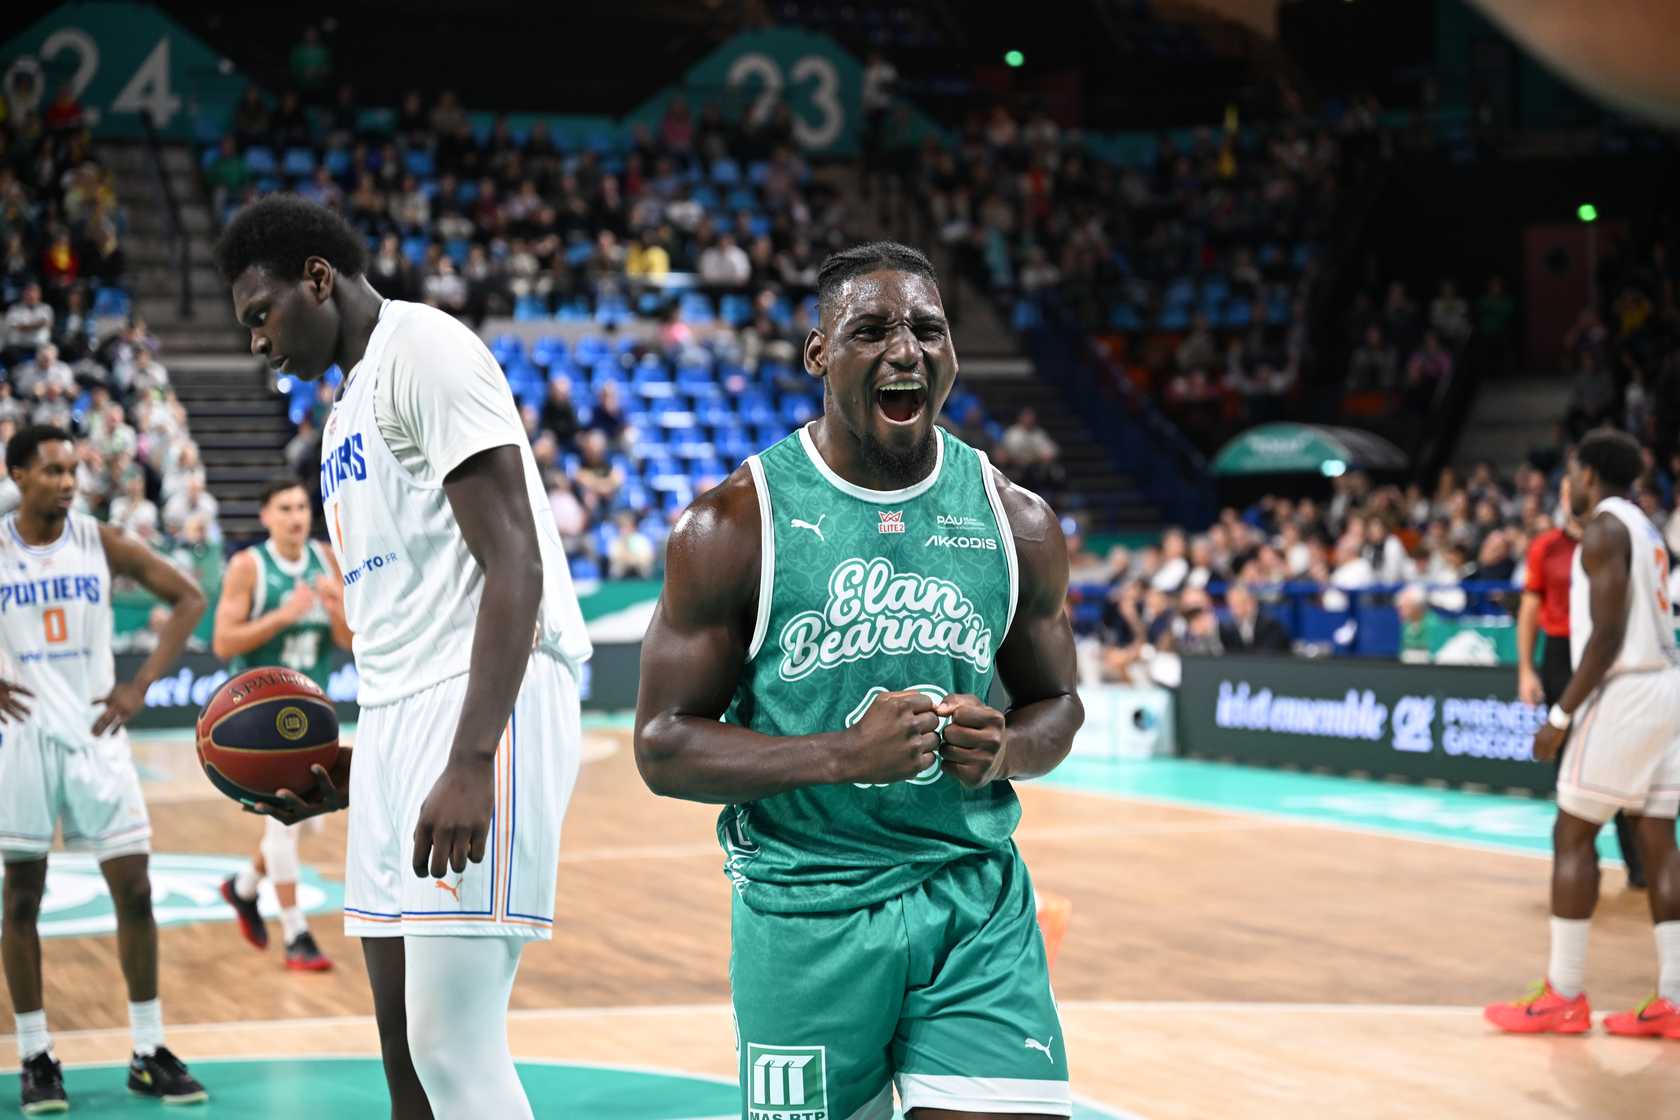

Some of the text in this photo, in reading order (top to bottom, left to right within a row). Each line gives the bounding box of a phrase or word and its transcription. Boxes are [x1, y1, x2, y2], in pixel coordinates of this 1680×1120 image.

[40, 28, 182, 128] 24
[728, 53, 843, 148] 23
[936, 514, 963, 526] PAU
[43, 607, 68, 643] 0
[826, 557, 973, 628] Elan
